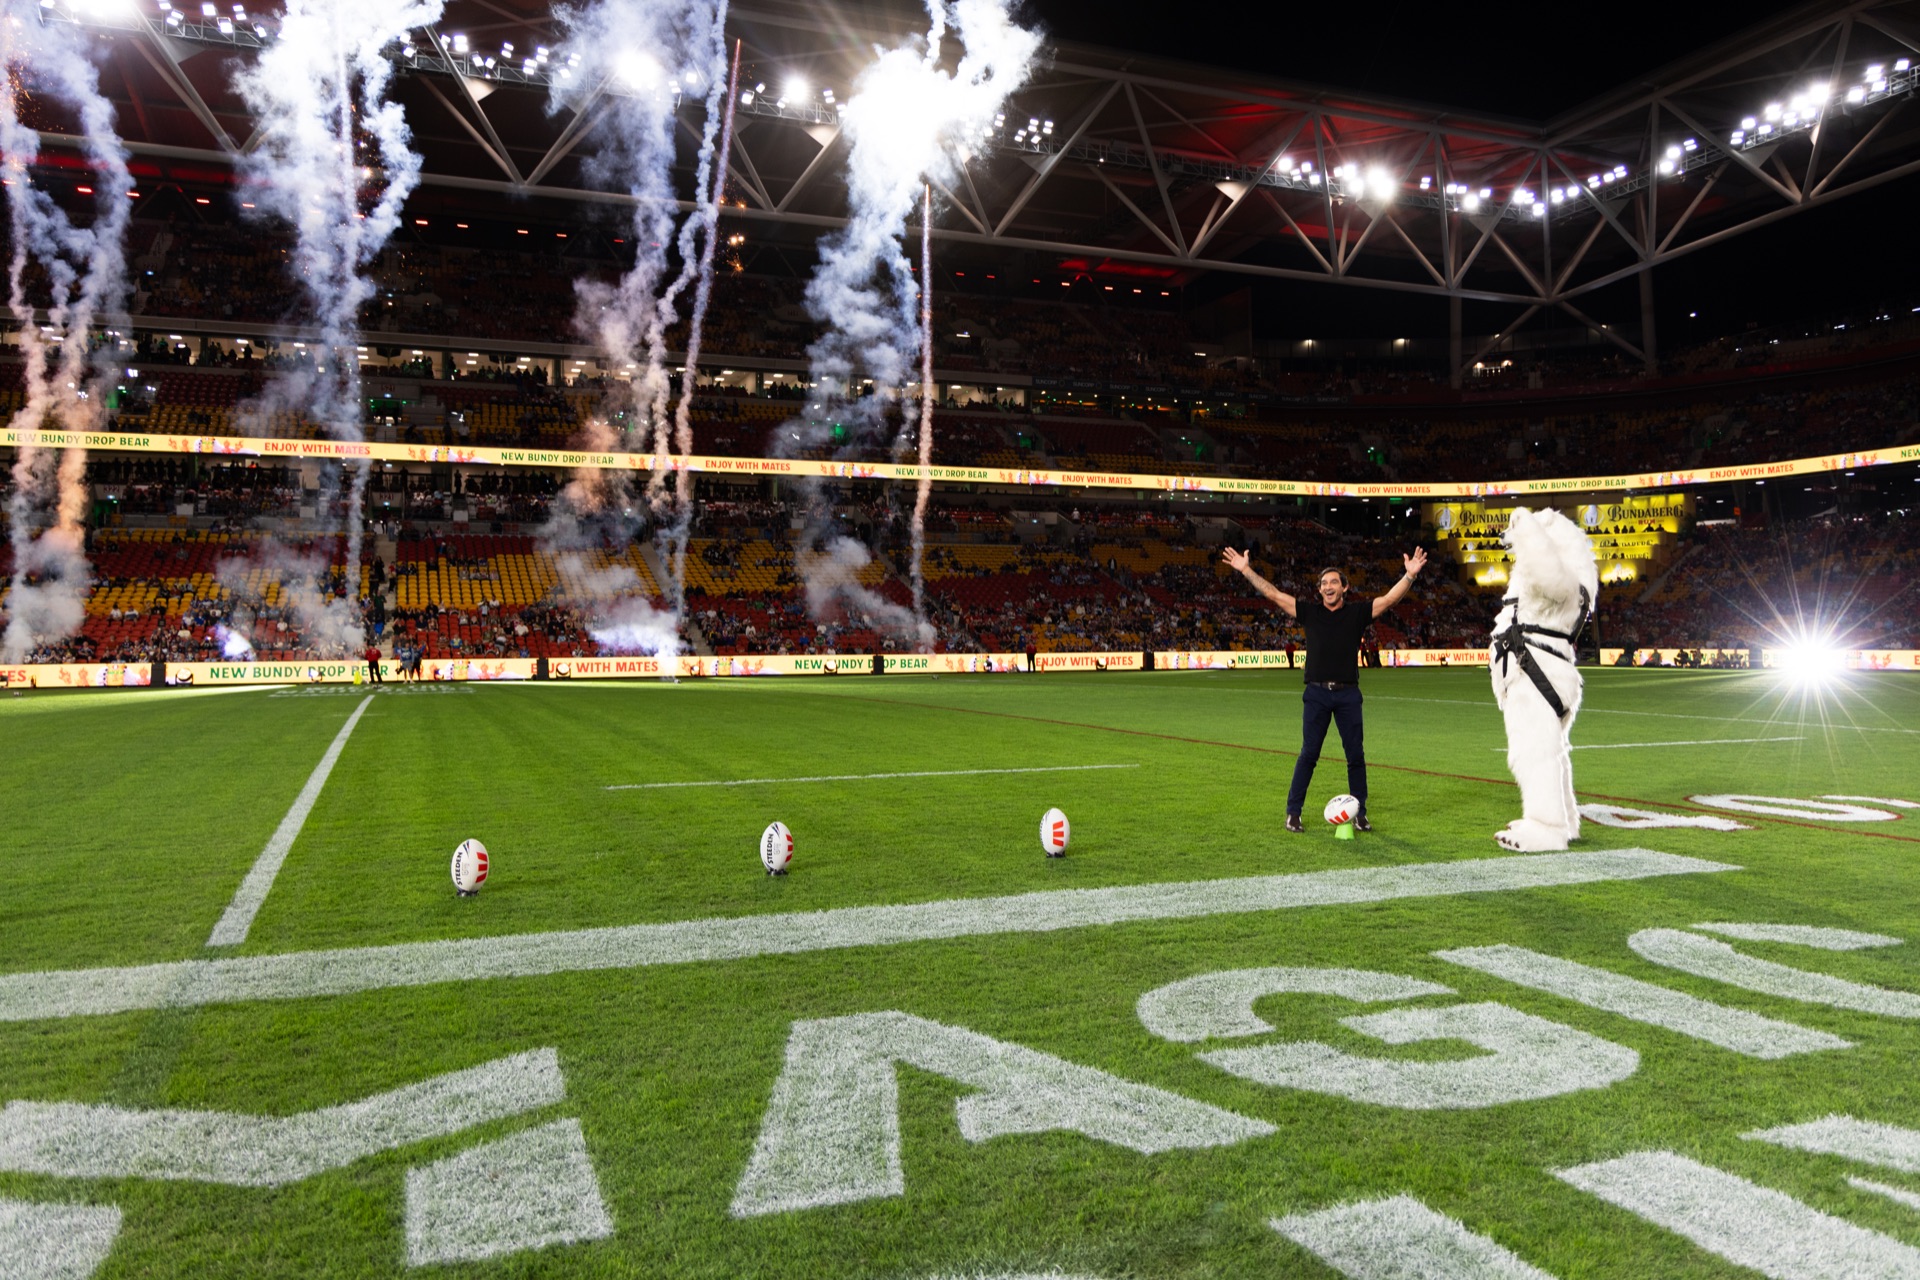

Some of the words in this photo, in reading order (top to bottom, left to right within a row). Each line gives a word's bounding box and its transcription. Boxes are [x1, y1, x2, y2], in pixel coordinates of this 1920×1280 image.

[7, 432, 37, 442] NEW
[41, 434, 82, 444] BUNDY
[85, 434, 116, 446] DROP
[120, 436, 150, 447] BEAR
[264, 442, 298, 453] ENJOY
[302, 443, 331, 454] WITH
[334, 444, 371, 456] MATES
[1901, 448, 1920, 458] NEW
[501, 452, 525, 462] NEW
[528, 452, 560, 463] BUNDY
[562, 454, 587, 464] DROP
[590, 455, 614, 465] BEAR
[705, 459, 732, 469] ENJOY
[735, 460, 759, 470] WITH
[761, 461, 791, 472] MATES
[1710, 468, 1738, 479] ENJOY
[1740, 466, 1766, 476] WITH
[1768, 464, 1794, 474] MATES
[895, 468, 915, 476] NEW
[918, 468, 944, 478] BUNDY
[946, 469, 966, 478] DROP
[968, 470, 988, 479] BEAR
[1062, 474, 1084, 484] ENJOY
[1087, 475, 1106, 484] WITH
[1108, 476, 1133, 485] MATES
[1218, 481, 1234, 489] NEW
[1236, 482, 1258, 490] BUNDY
[1260, 482, 1278, 490] DROP
[1278, 483, 1296, 491] BEAR
[1357, 486, 1382, 494] ENJOY
[1383, 486, 1403, 494] WITH
[1406, 486, 1432, 494] MATES
[1528, 482, 1548, 490] NEW
[1551, 481, 1577, 490] BUNDY
[1580, 479, 1603, 488] DROP
[1605, 478, 1627, 488] BEAR
[1608, 504, 1684, 522] BUNDABERG
[1036, 656, 1068, 668] ENJOY
[1070, 656, 1097, 667] WITH
[1238, 655, 1260, 664] NEW
[1263, 654, 1286, 664] BUND
[1295, 654, 1306, 664] DR
[1454, 653, 1474, 662] WITH
[577, 662, 611, 674] WITH
[616, 660, 659, 672] MATES
[794, 658, 822, 670] NEW
[836, 658, 864, 670] UNDY
[868, 658, 897, 669] DOP
[900, 658, 928, 668] BEAR
[210, 667, 247, 679] NEW
[252, 666, 302, 678] BUNDY
[351, 664, 388, 677] BER
